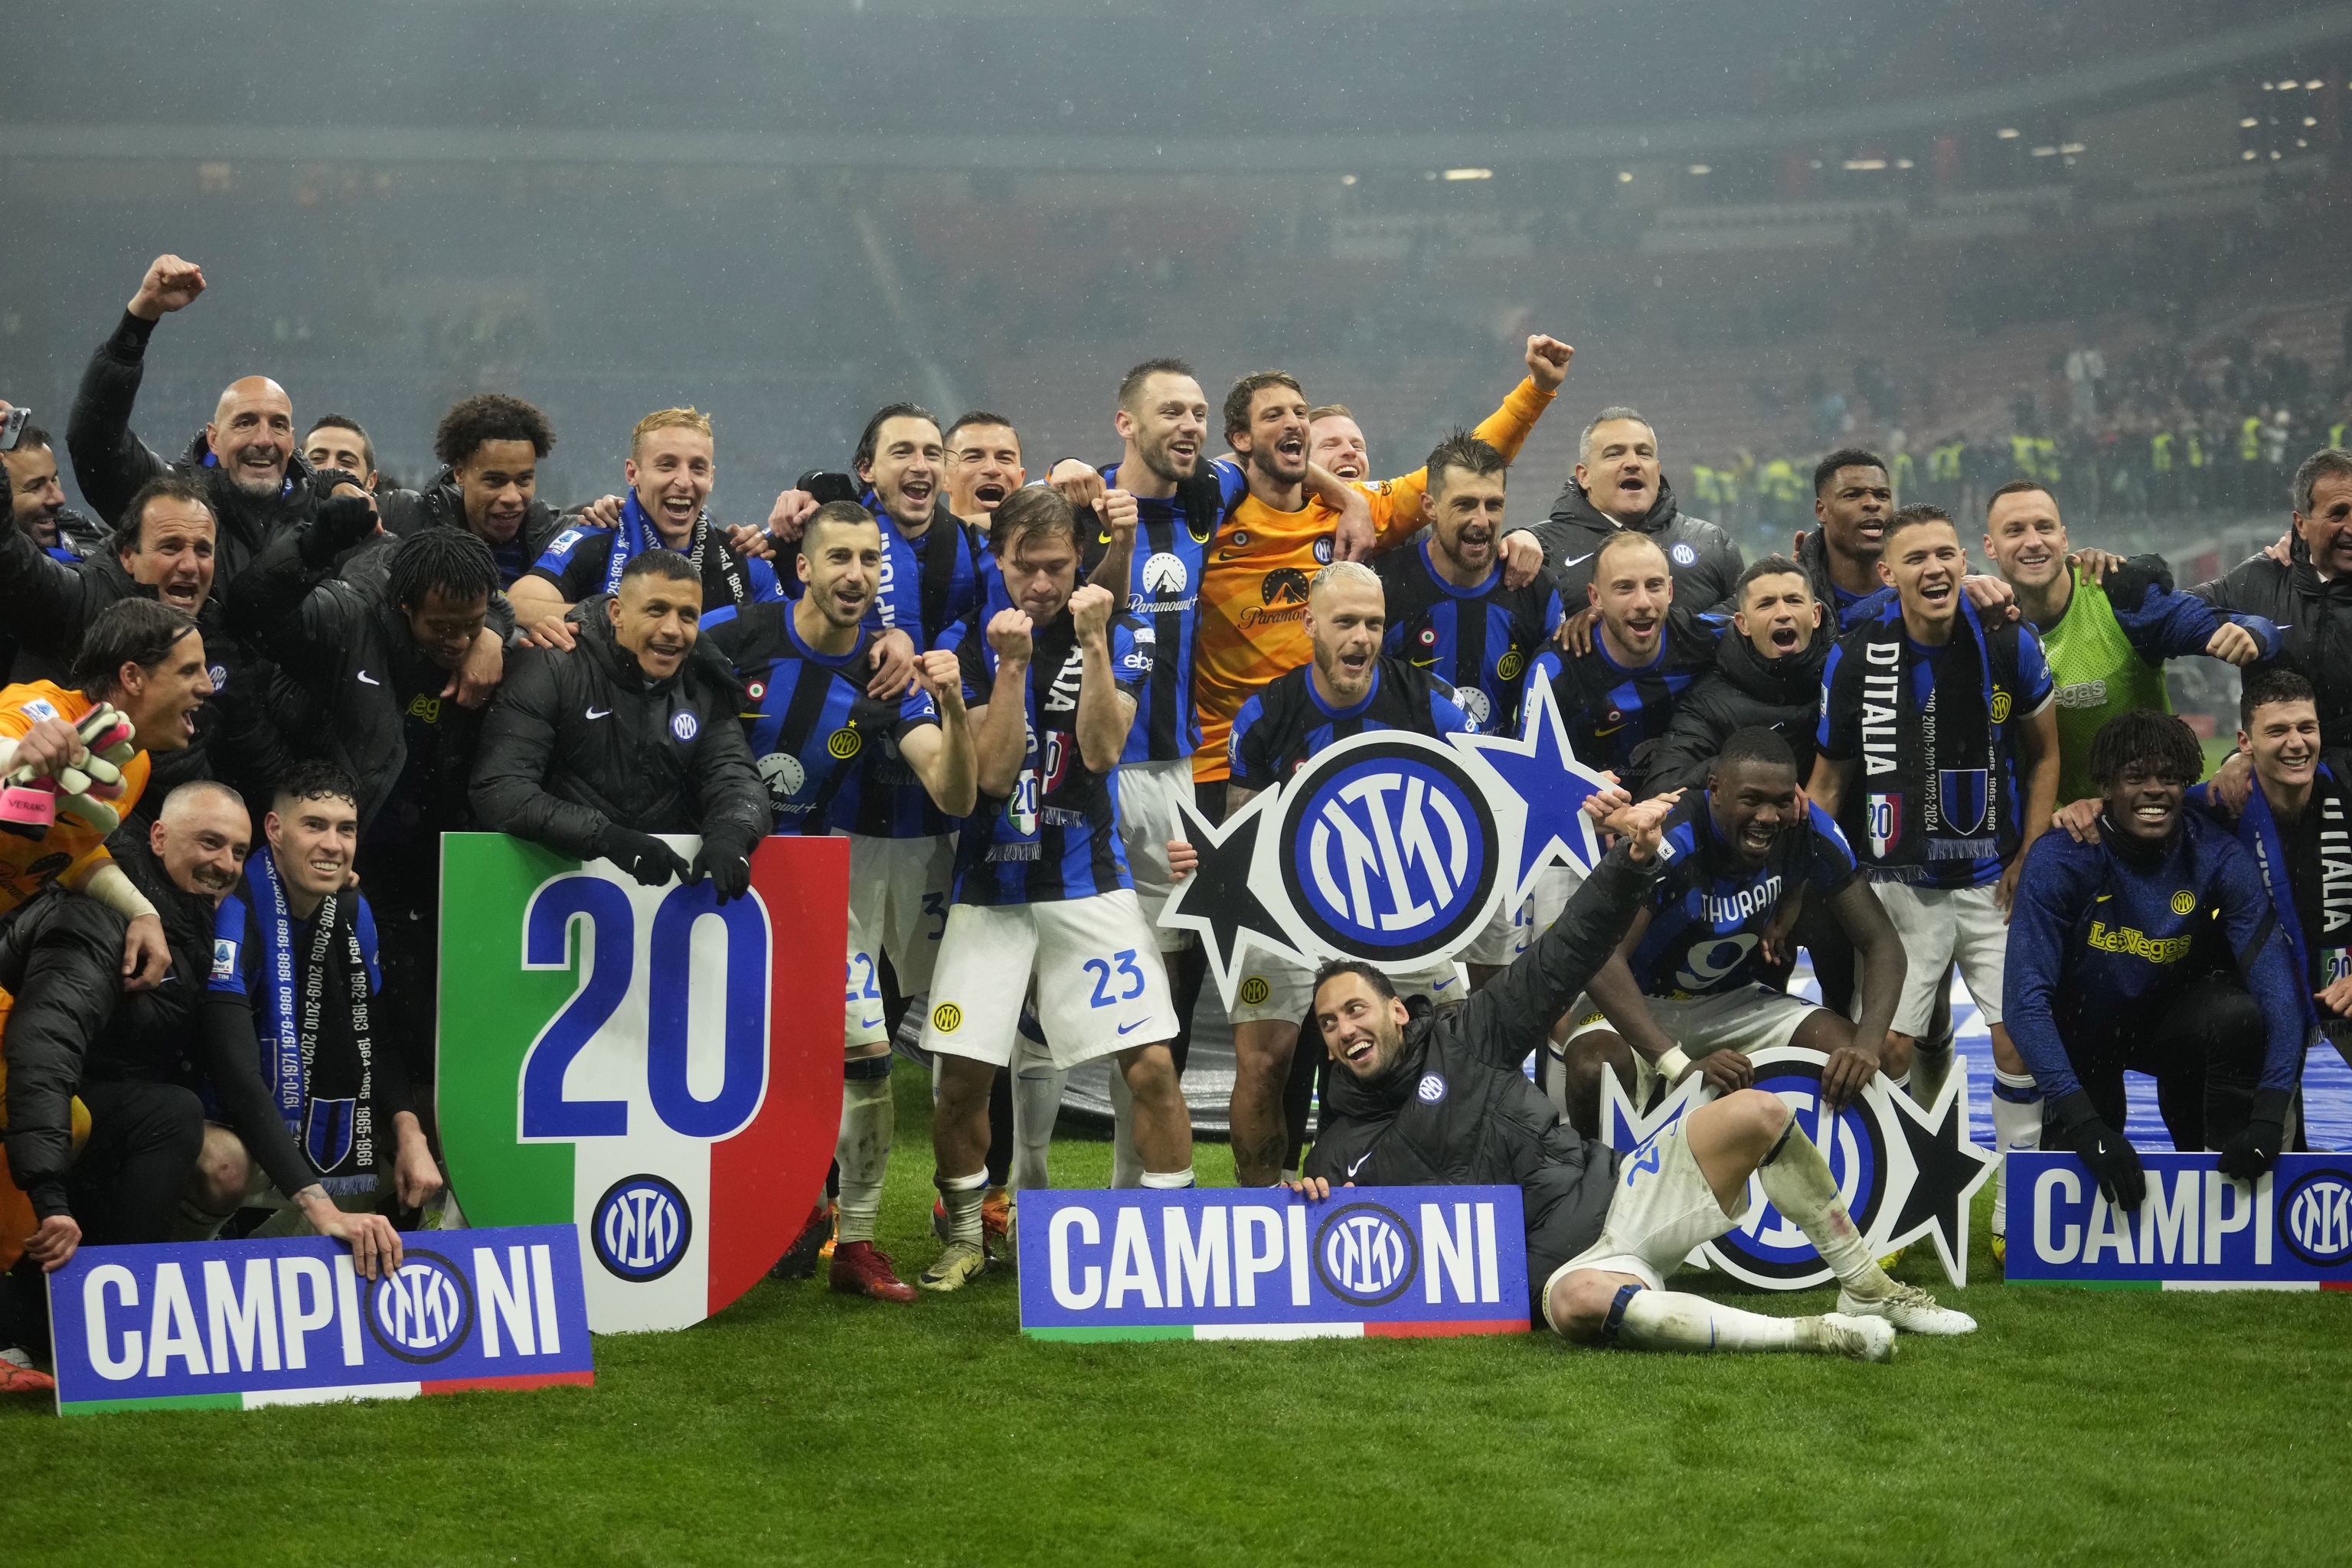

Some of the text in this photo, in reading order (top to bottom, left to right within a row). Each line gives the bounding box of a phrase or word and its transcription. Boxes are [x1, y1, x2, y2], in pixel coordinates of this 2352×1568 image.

[1861, 642, 1900, 776] D'ITALIA
[2053, 679, 2107, 708] egas
[8, 798, 47, 813] VERANO
[769, 799, 818, 815] ount+
[1867, 801, 1893, 840] 20
[1924, 773, 1939, 831] 2023-2024
[1988, 776, 1997, 831] 1965-1966
[310, 895, 338, 962] 2008-2009
[1702, 875, 1782, 923] THURAM
[276, 919, 292, 982] 1988-1989
[1083, 949, 1145, 1009] 23
[279, 986, 297, 1049] 1979-1980
[303, 965, 325, 1031] 2009-2010
[350, 971, 369, 1031] 1962-1963
[521, 875, 769, 1139] 20
[281, 1053, 301, 1110] 1970-1971
[356, 1106, 374, 1166] 1965-1966
